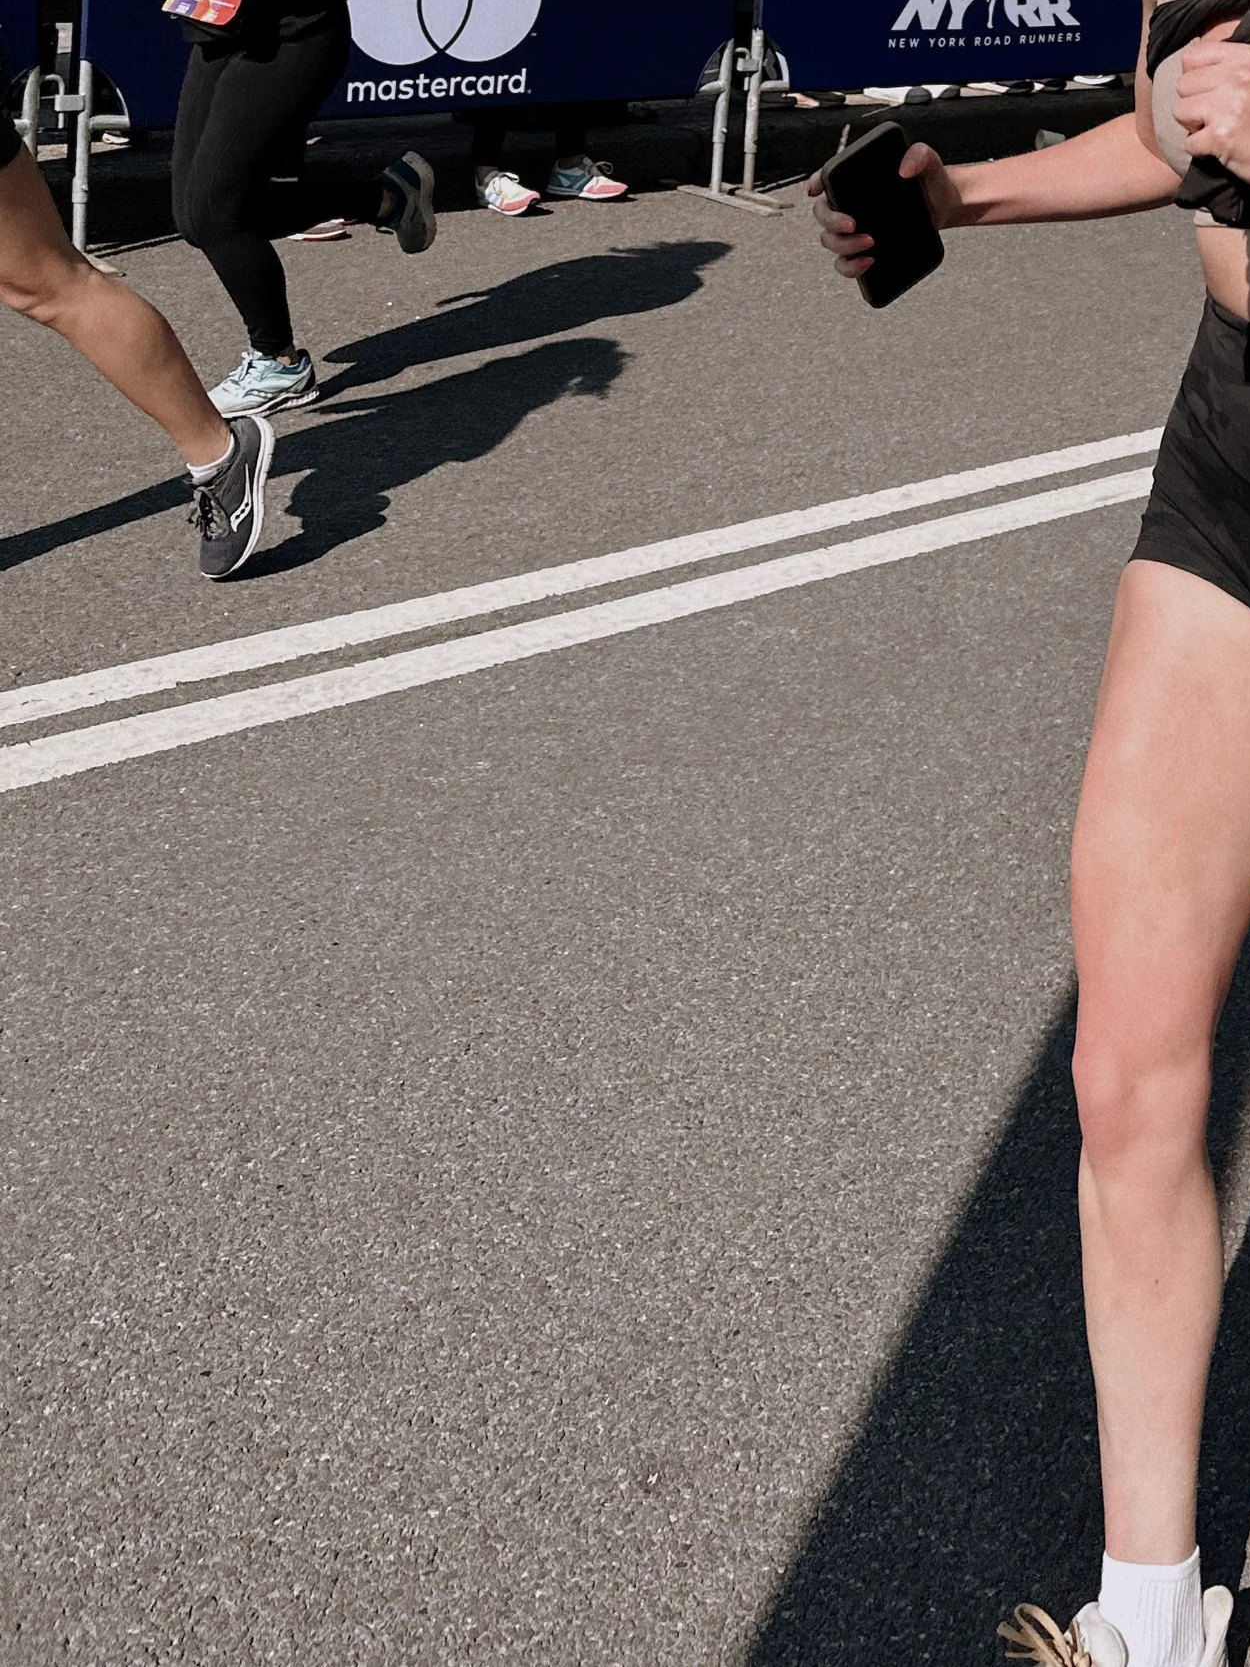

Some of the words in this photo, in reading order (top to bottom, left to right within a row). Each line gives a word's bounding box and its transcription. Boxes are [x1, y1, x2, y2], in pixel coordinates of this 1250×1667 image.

[888, 38, 920, 48] NEW
[929, 37, 966, 47] YORK
[974, 35, 1011, 46] ROAD
[1019, 32, 1081, 45] RUNNERS
[346, 67, 527, 103] mastercard
